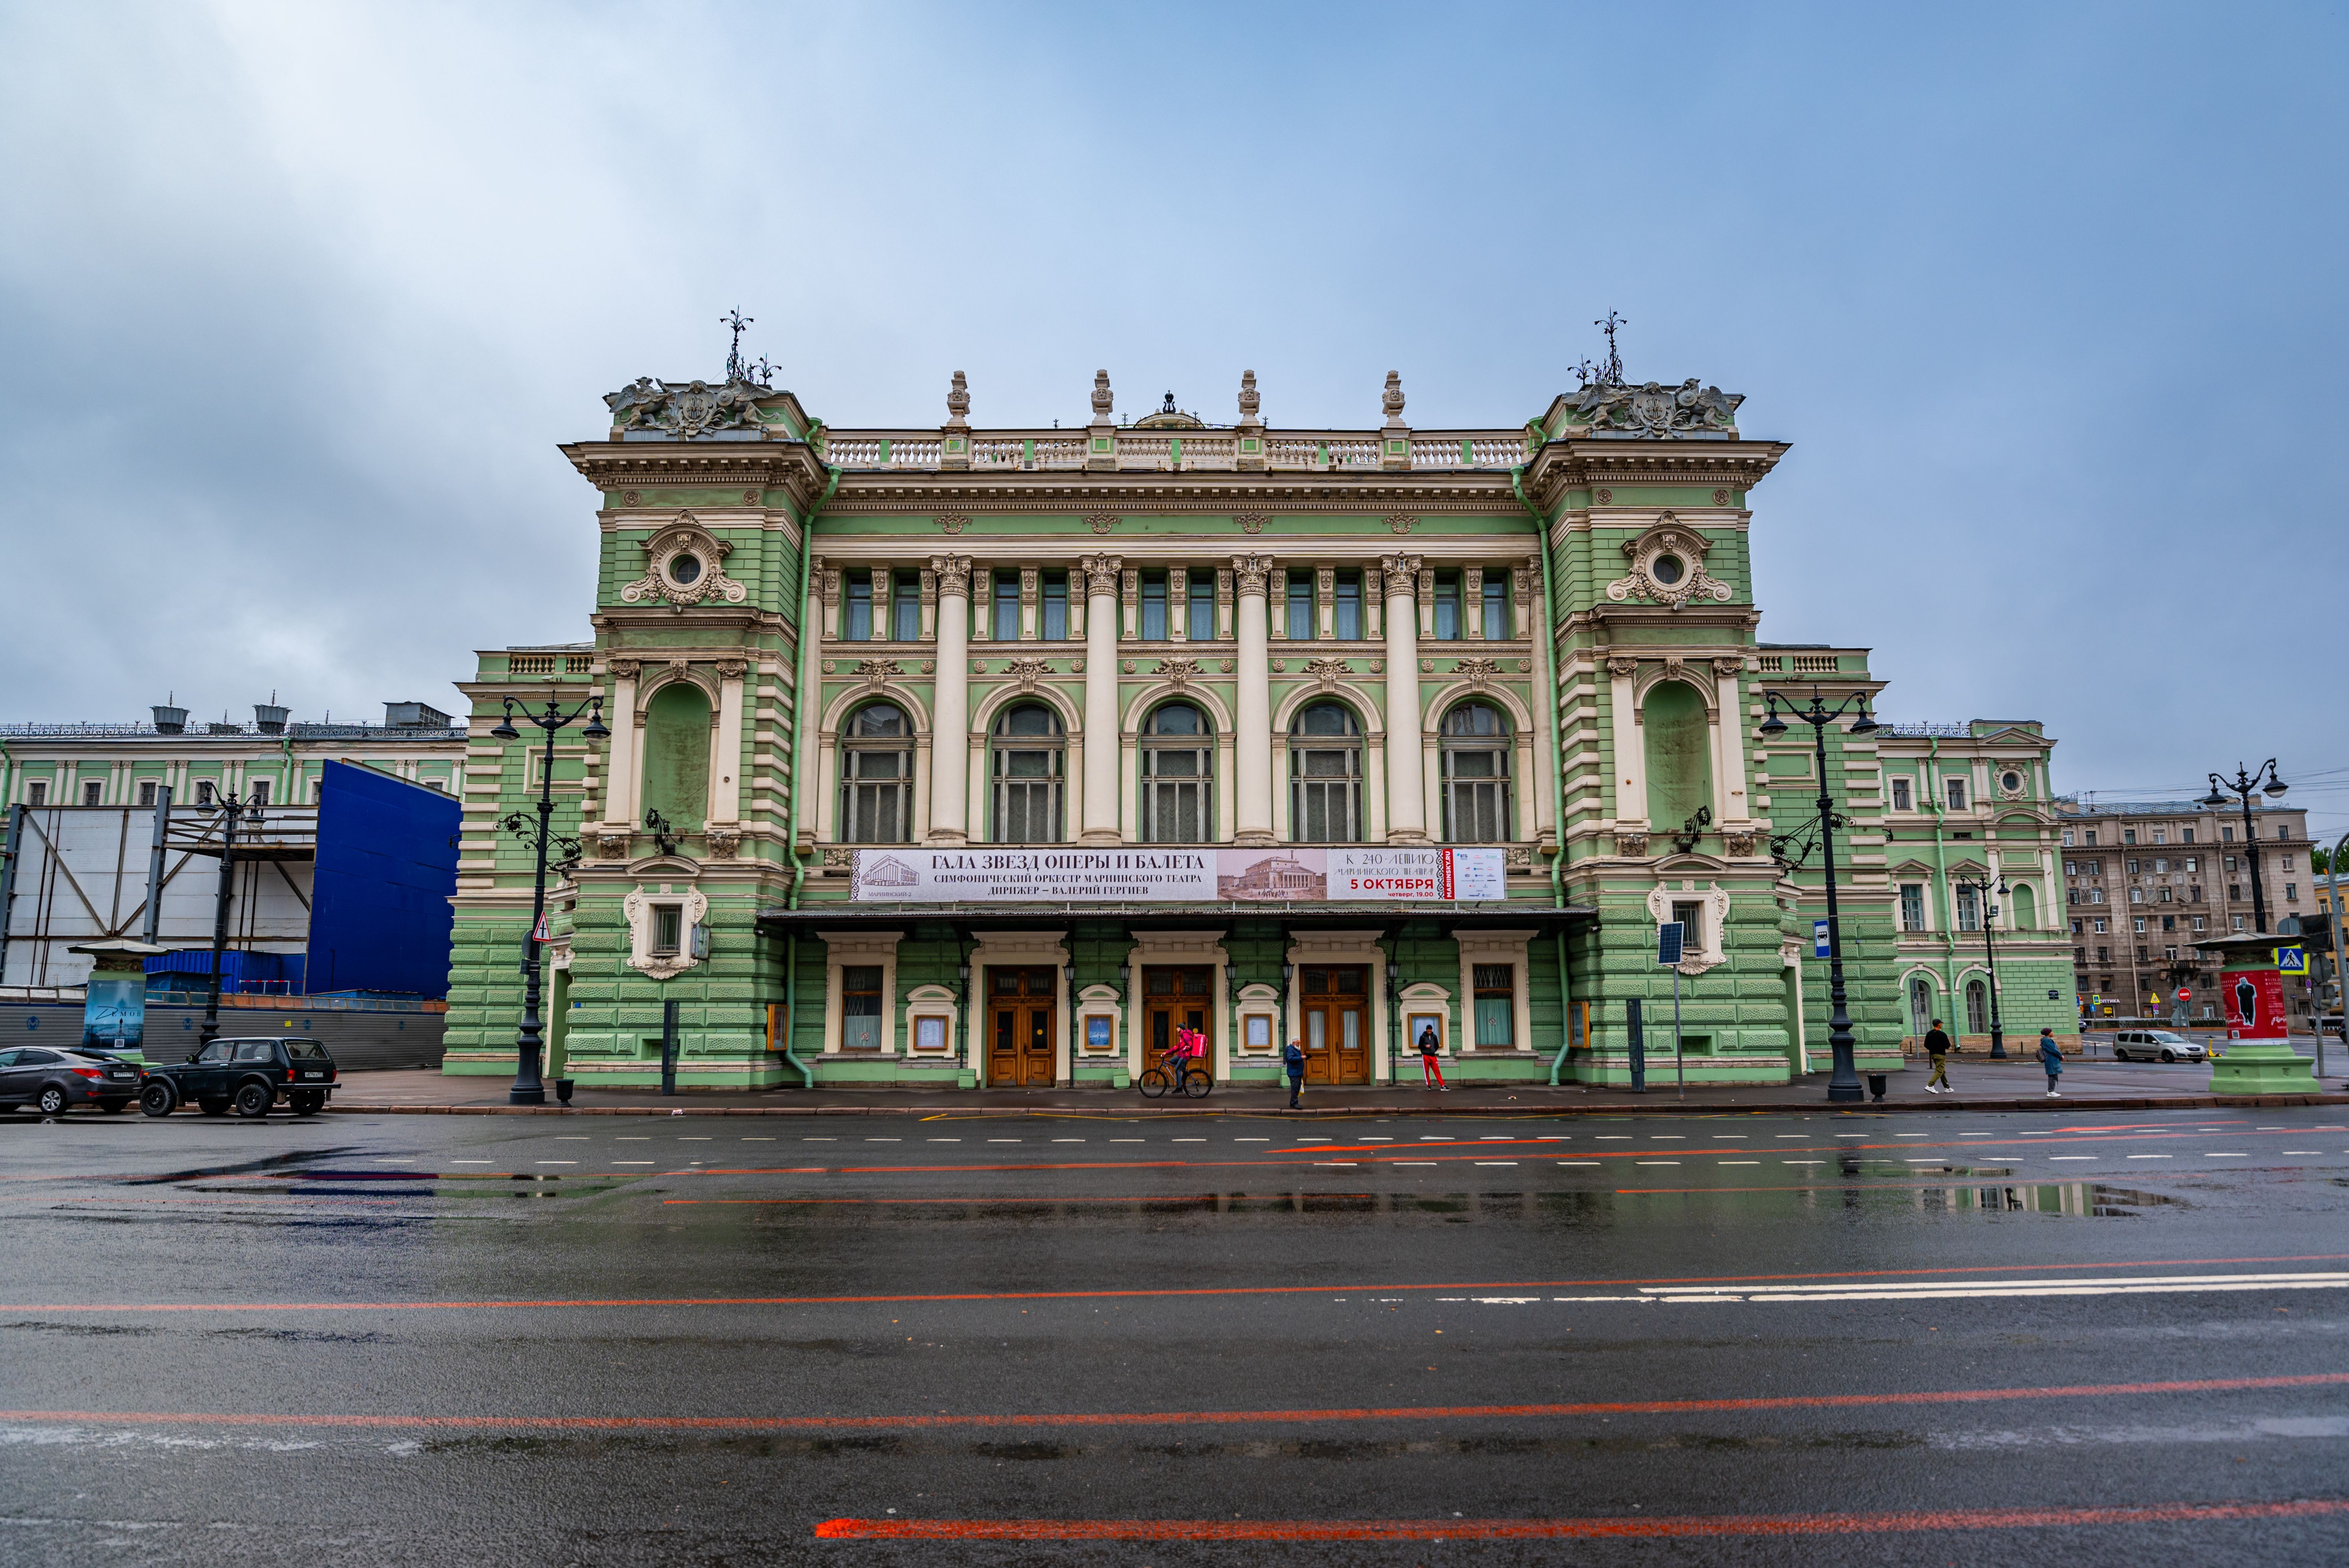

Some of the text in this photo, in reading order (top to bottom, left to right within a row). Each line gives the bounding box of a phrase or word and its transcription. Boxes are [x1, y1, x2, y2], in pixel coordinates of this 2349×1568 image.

[931, 855, 1205, 872] ГАЛА ЗВЕЗД ОПЕРЫ И БАЛЕТА
[1347, 854, 1353, 864] К
[934, 873, 1202, 883] СИМФОНИЧЕСКИЙ ОРКЕСТР МАРИИНСКОГО ТЕАТРА
[1351, 879, 1433, 889] 5 ОКТЯБРЯ
[988, 886, 1039, 896] ДИРИЖЕР
[1052, 885, 1100, 895] ВАЛЕРИЙ
[1104, 886, 1148, 895] ГЕРГИЕВ
